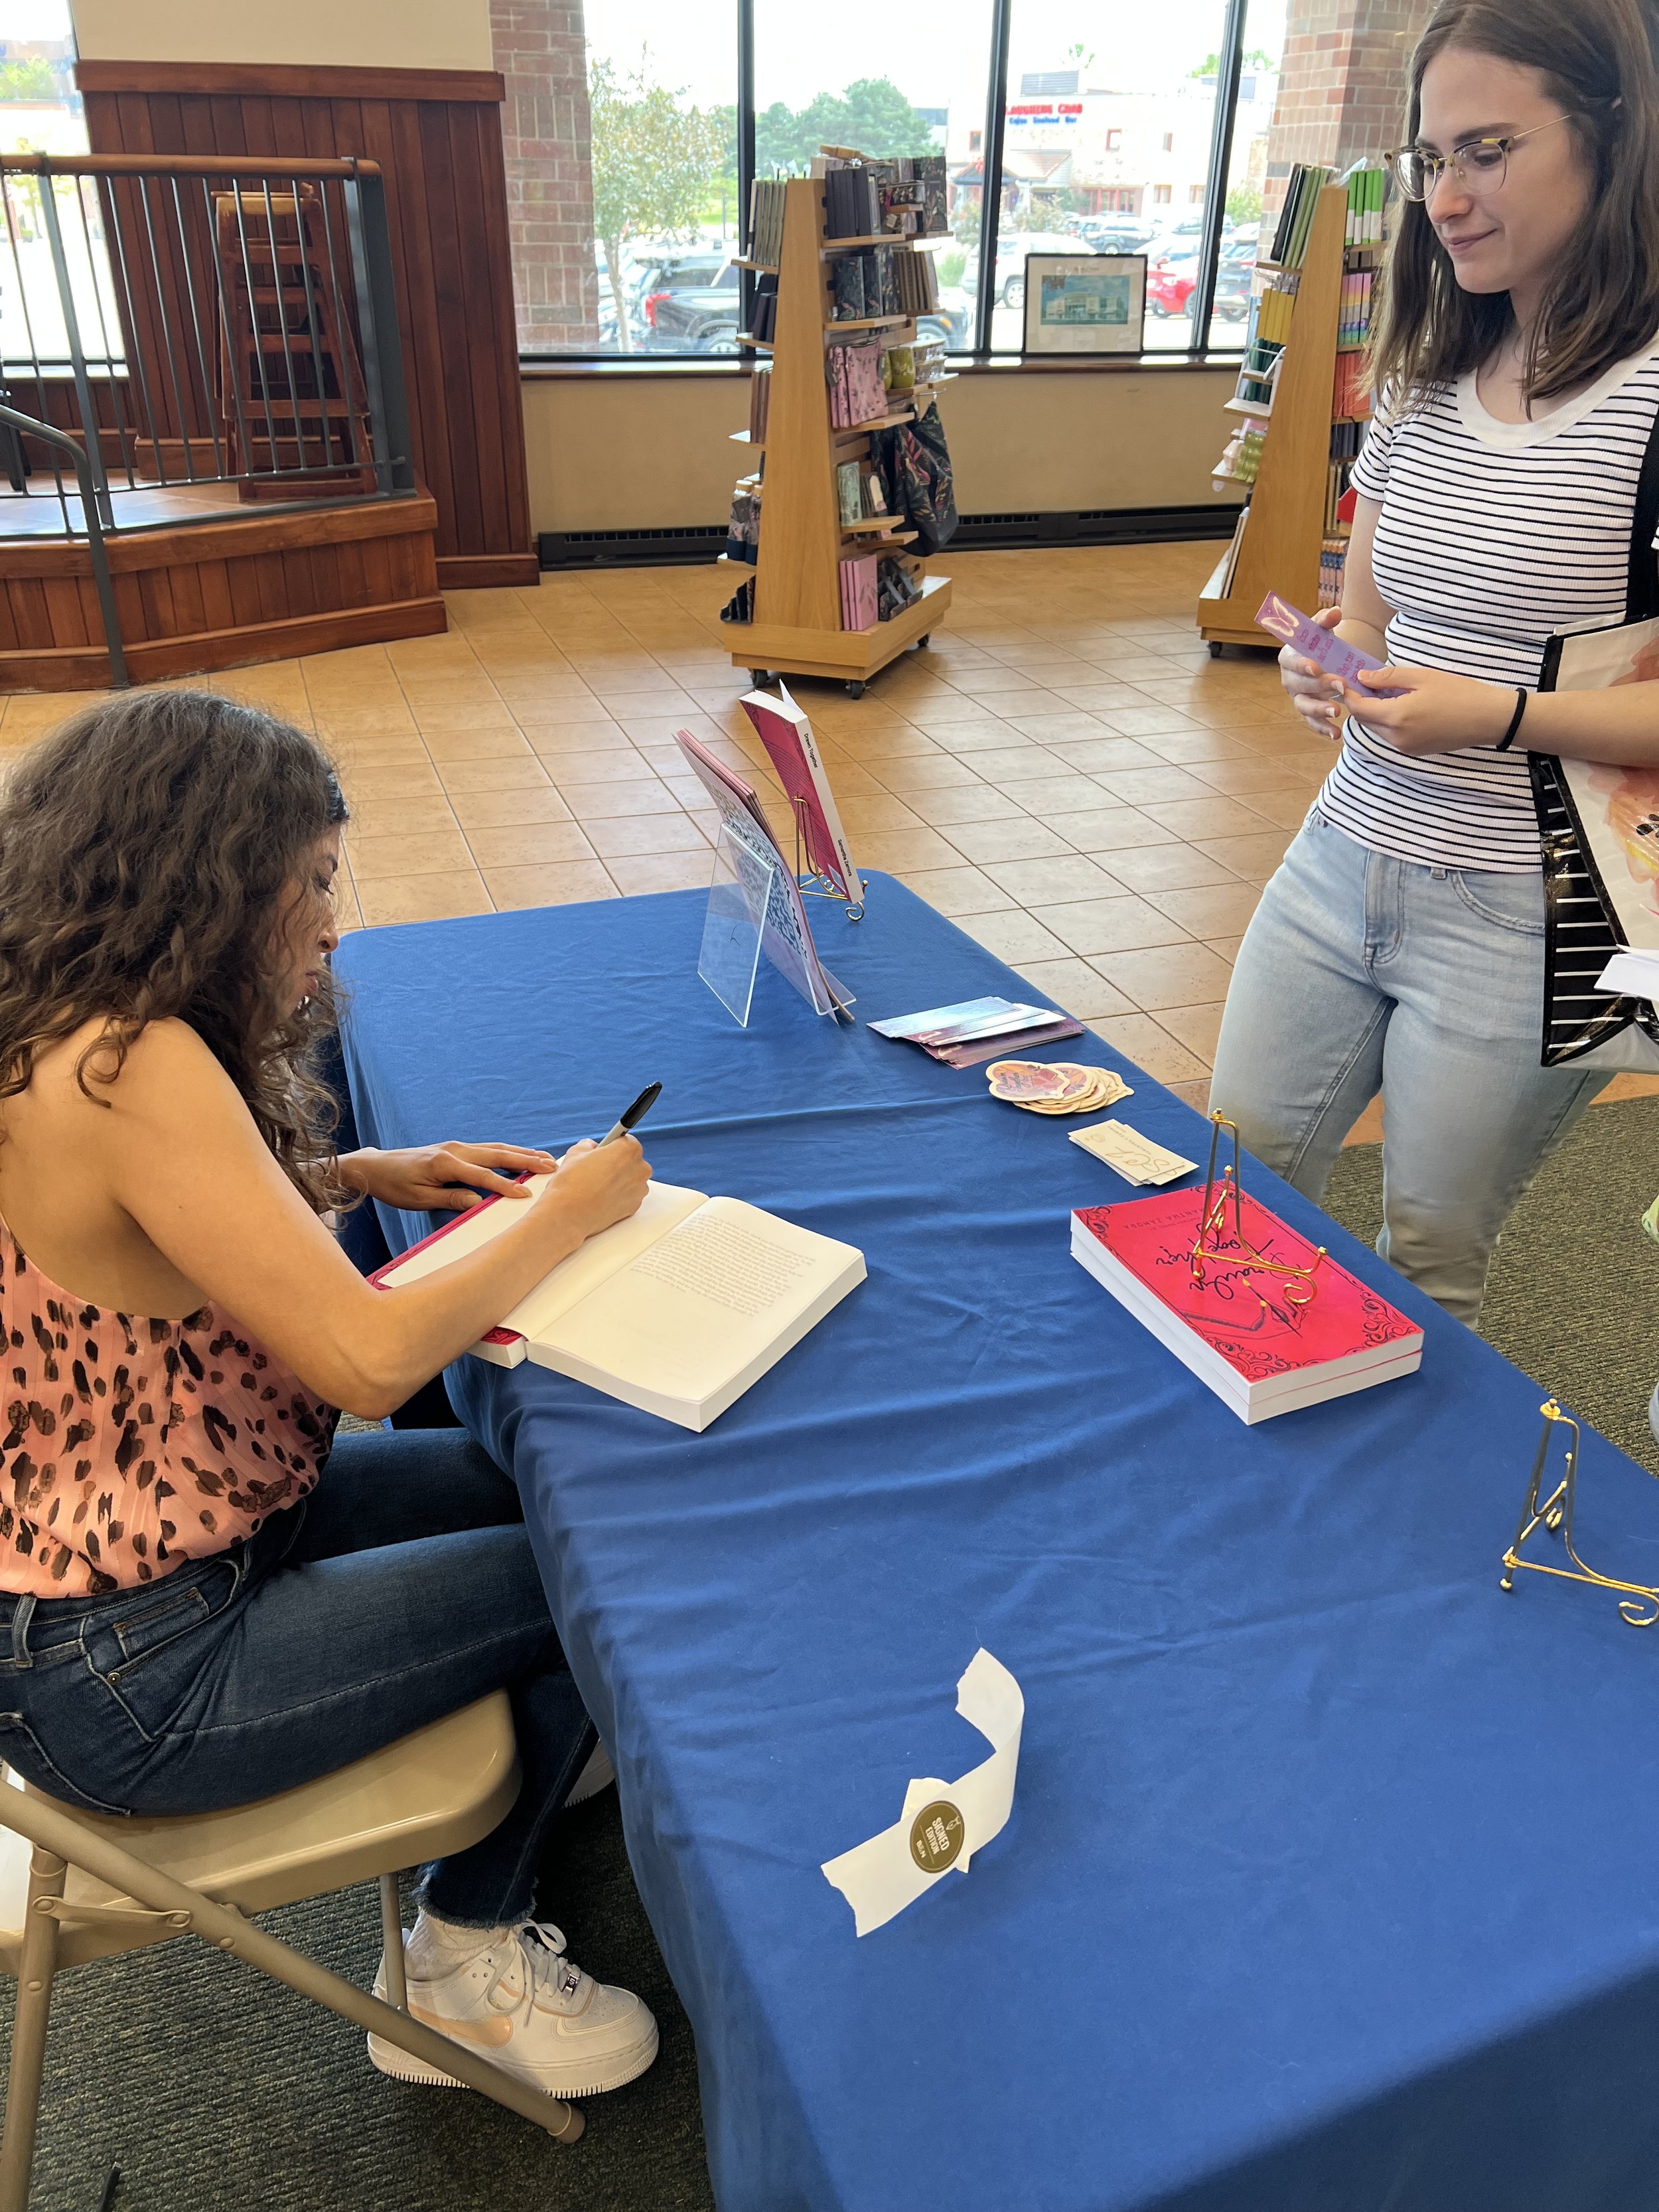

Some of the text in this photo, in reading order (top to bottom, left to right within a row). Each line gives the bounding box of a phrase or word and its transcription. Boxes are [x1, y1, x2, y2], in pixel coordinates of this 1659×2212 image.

[809, 749, 818, 769] Together
[837, 839, 847, 861] Samantha
[1122, 1218, 1161, 1230] ZAMORA
[926, 1826, 940, 1854] EDITION
[932, 1816, 950, 1851] SIGNED
